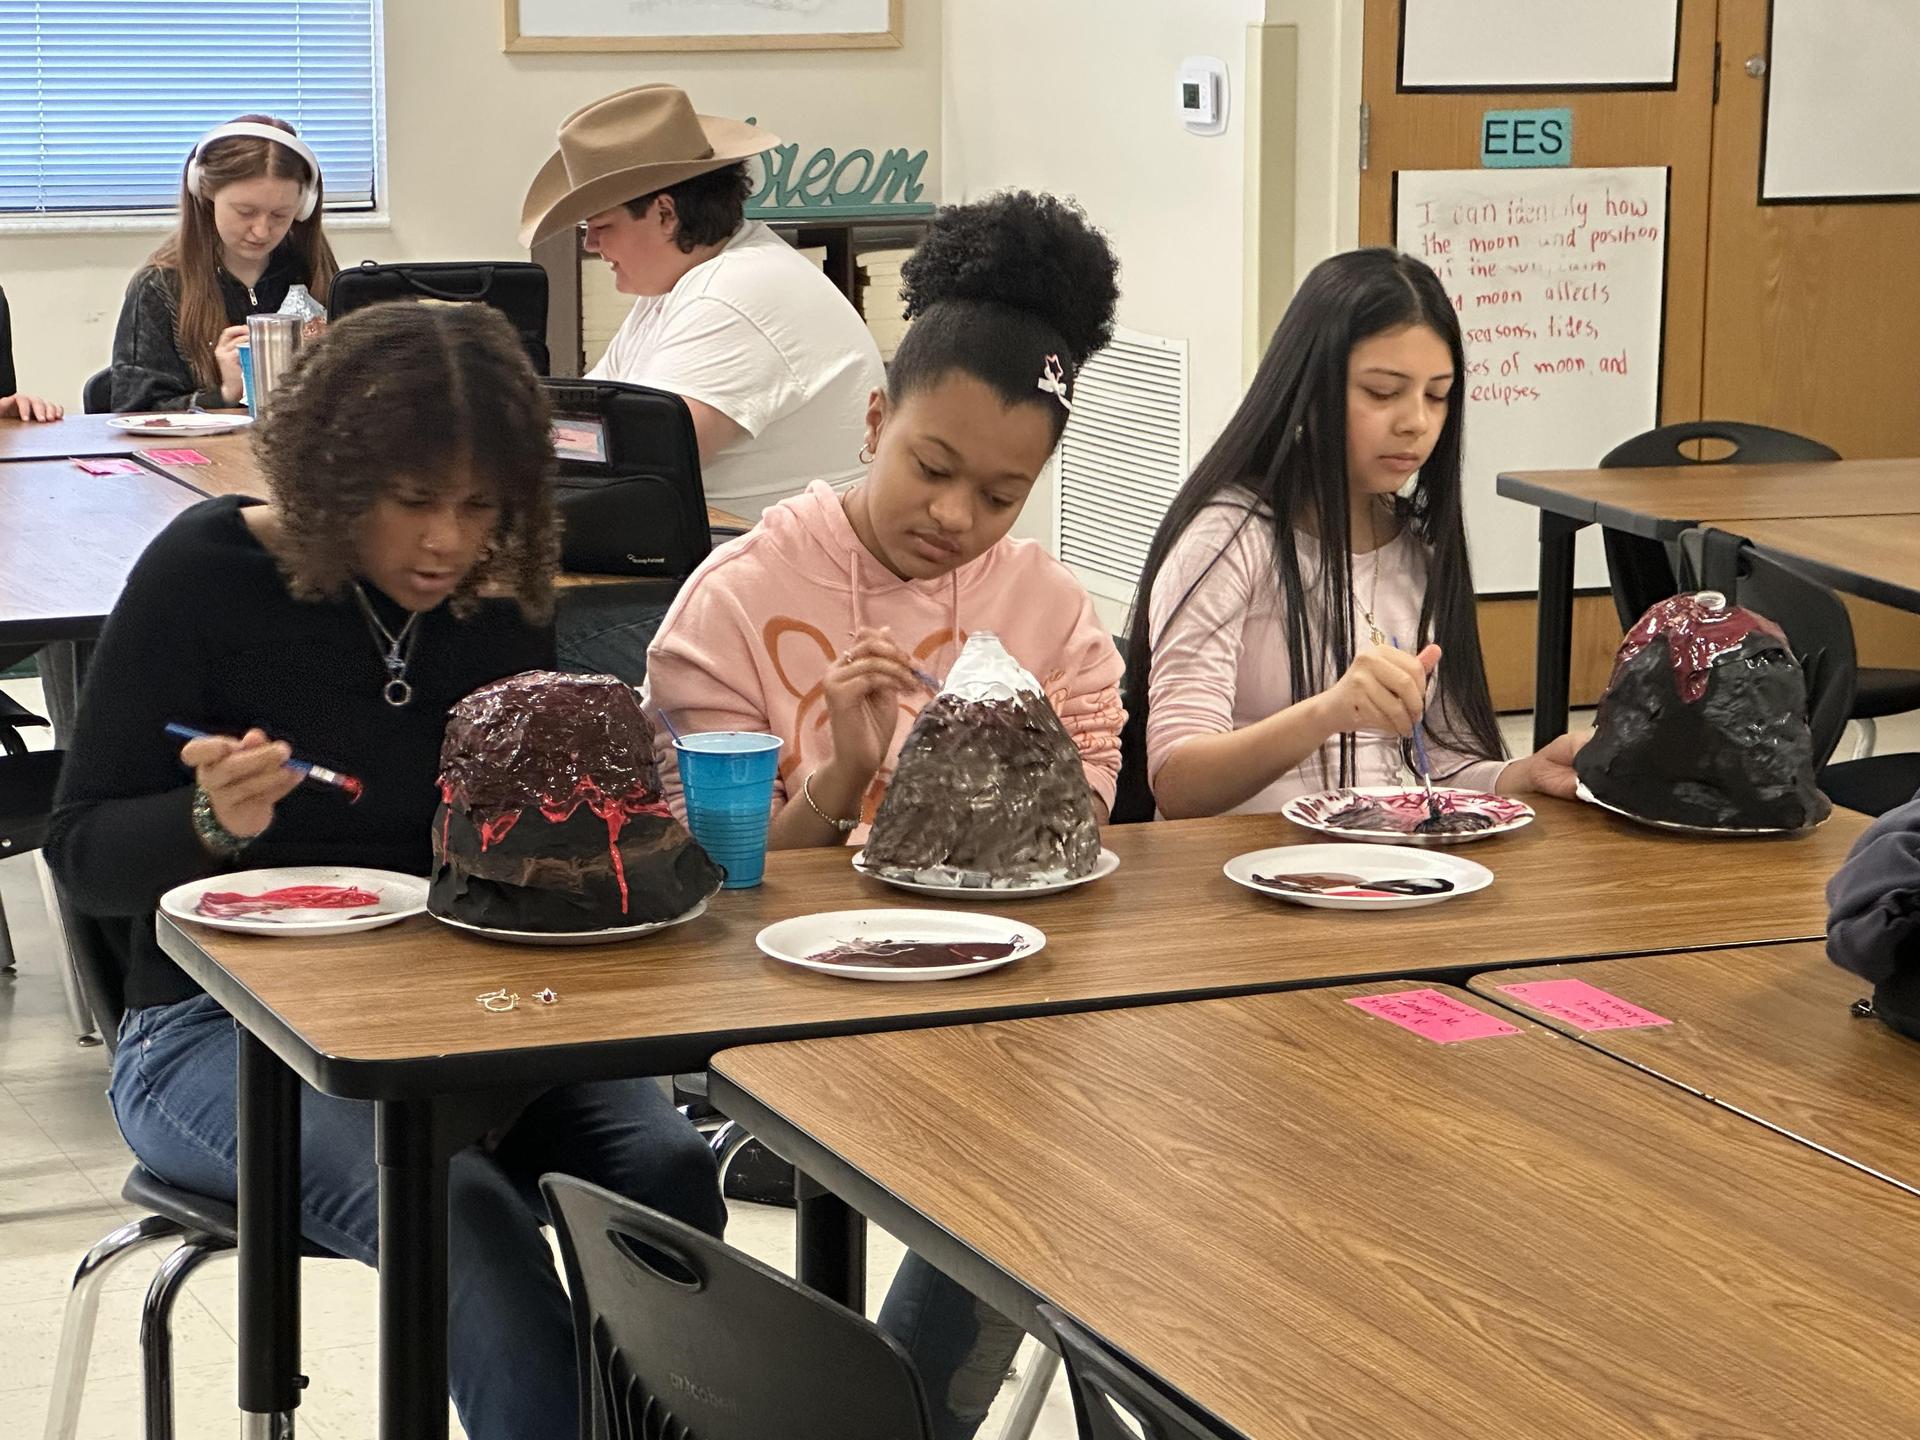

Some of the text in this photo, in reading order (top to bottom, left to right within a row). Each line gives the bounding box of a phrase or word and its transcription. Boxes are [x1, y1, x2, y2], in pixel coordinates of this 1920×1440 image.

[1484, 119, 1563, 155] EES
[1416, 200, 1440, 228] I
[1453, 203, 1497, 226] can
[1606, 187, 1648, 217] how
[1421, 231, 1452, 256] the
[1468, 234, 1519, 254] moon
[1590, 225, 1658, 253] position
[1476, 291, 1523, 308] moon
[1545, 281, 1610, 305] affects
[1500, 351, 1520, 377] of
[1600, 347, 1628, 376] and
[1470, 382, 1541, 407] eclipses
